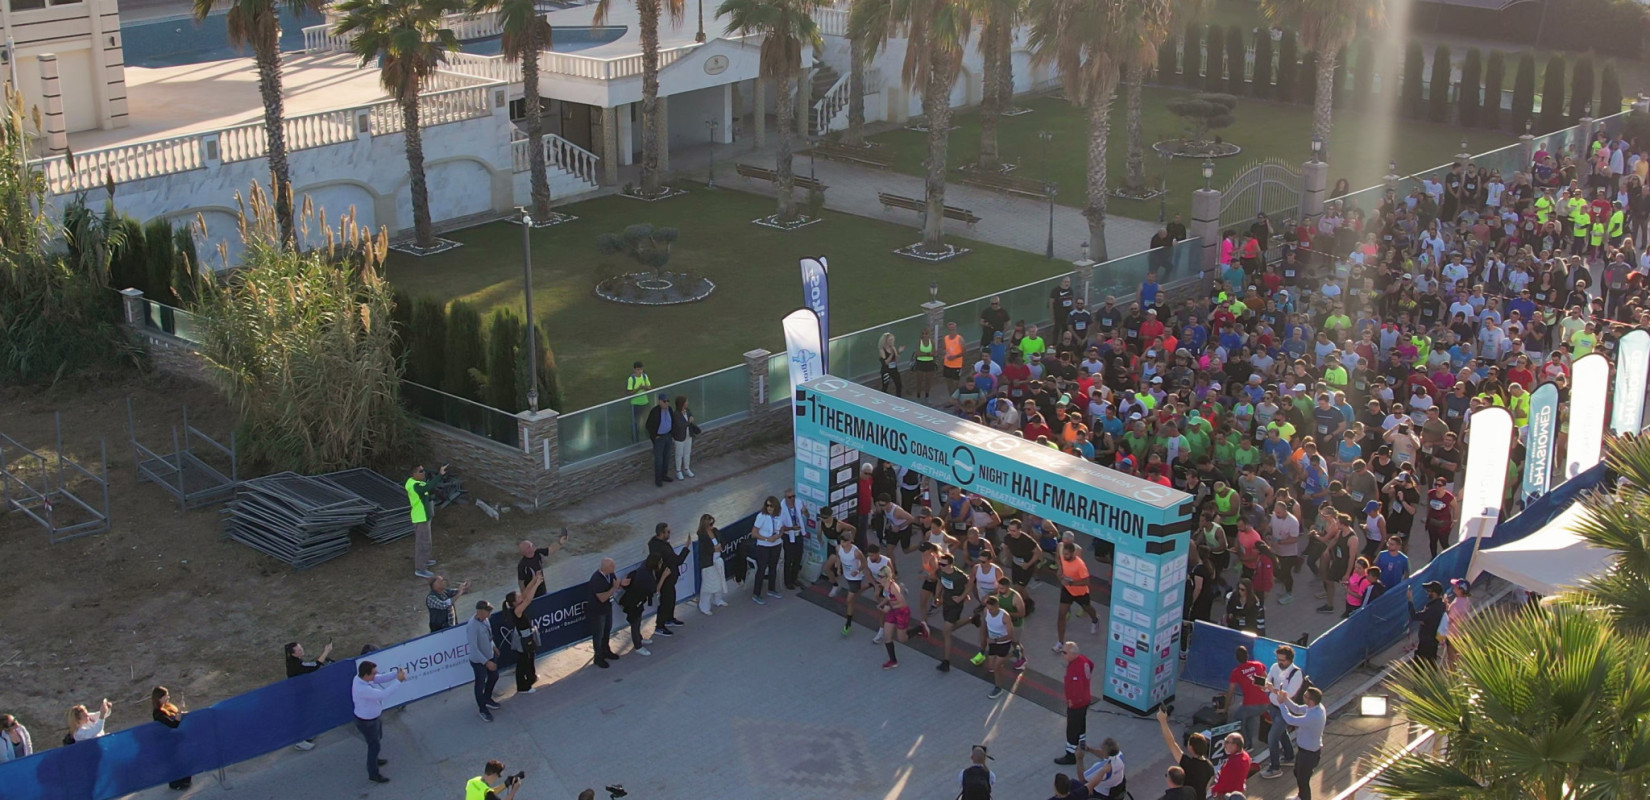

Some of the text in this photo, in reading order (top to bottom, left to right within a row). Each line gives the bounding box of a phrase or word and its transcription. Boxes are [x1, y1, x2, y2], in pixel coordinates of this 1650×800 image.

[818, 404, 907, 455] THERMAIKOS
[910, 440, 950, 467] COASTAL
[979, 464, 1009, 487] NIGHT
[1011, 471, 1144, 539] HALFMARATHON
